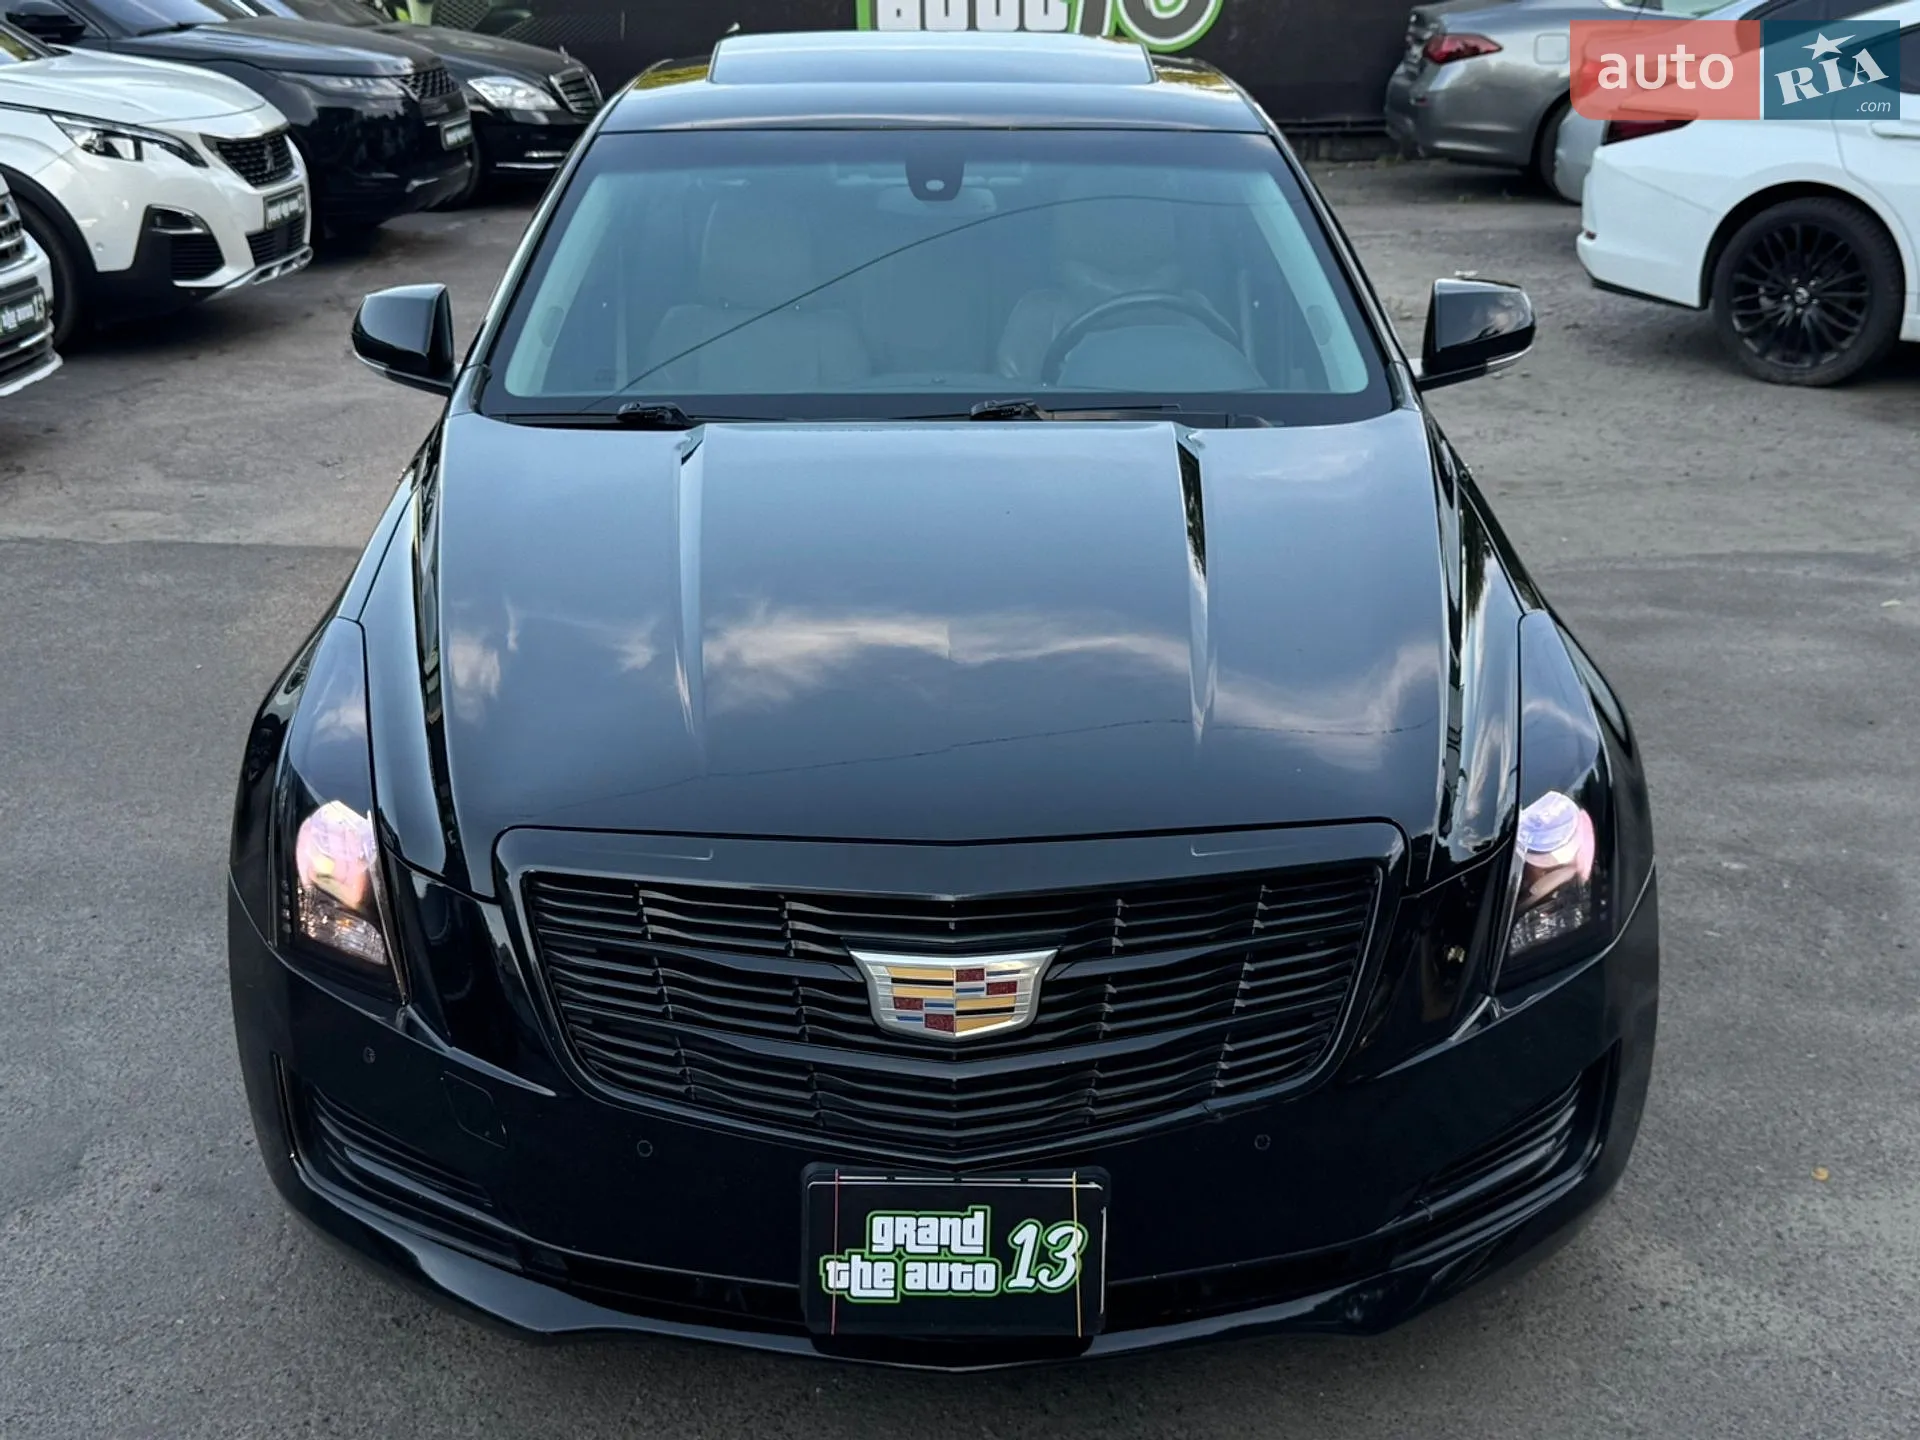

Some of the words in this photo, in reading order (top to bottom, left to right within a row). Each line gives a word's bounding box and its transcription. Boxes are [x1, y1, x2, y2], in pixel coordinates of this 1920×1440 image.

[825, 1254, 895, 1298] the
[905, 1261, 996, 1292] auto
[1007, 1223, 1084, 1289] 13
